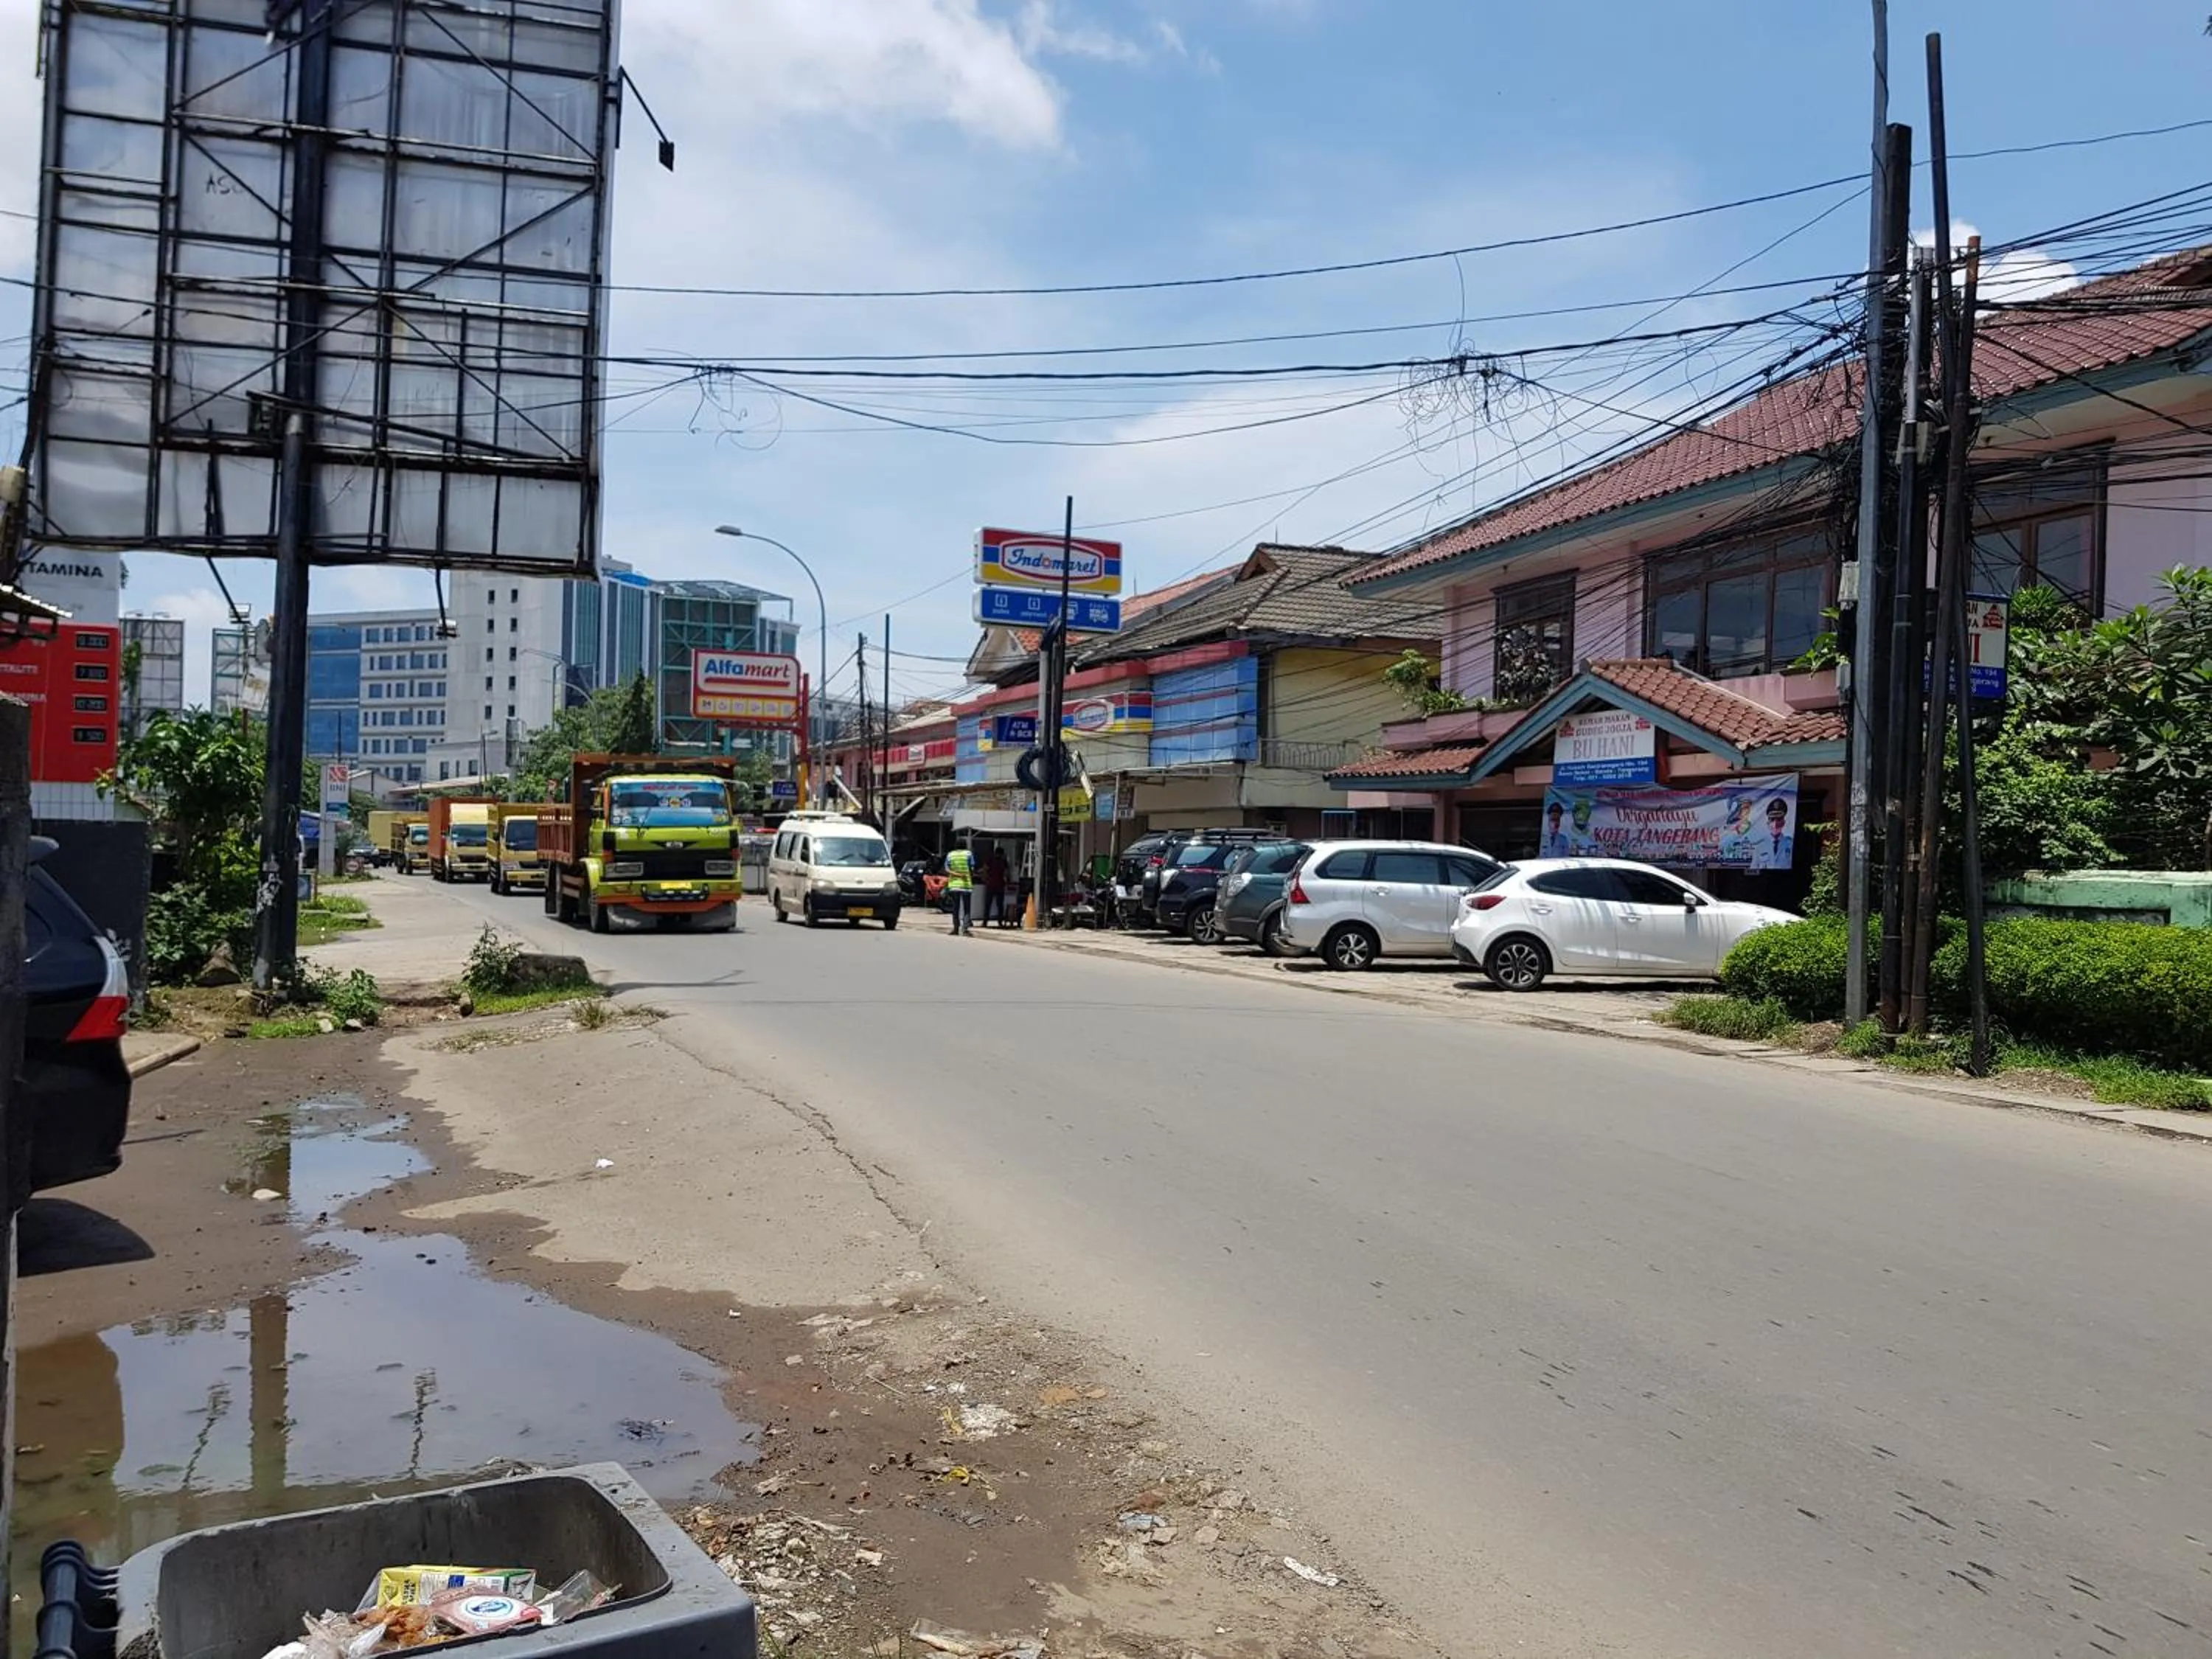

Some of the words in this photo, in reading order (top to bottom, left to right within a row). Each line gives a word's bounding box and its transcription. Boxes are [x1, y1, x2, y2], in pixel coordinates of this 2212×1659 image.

[27, 561, 104, 577] TAMINA
[1007, 548, 1096, 572] Indomaret
[705, 658, 790, 678] Alfamart
[1604, 714, 1630, 724] MAKAN
[1573, 739, 1592, 759] BU
[1597, 735, 1635, 758] HANI
[1593, 827, 1630, 843] KOTA
[1633, 827, 1720, 844] TANGERANG
